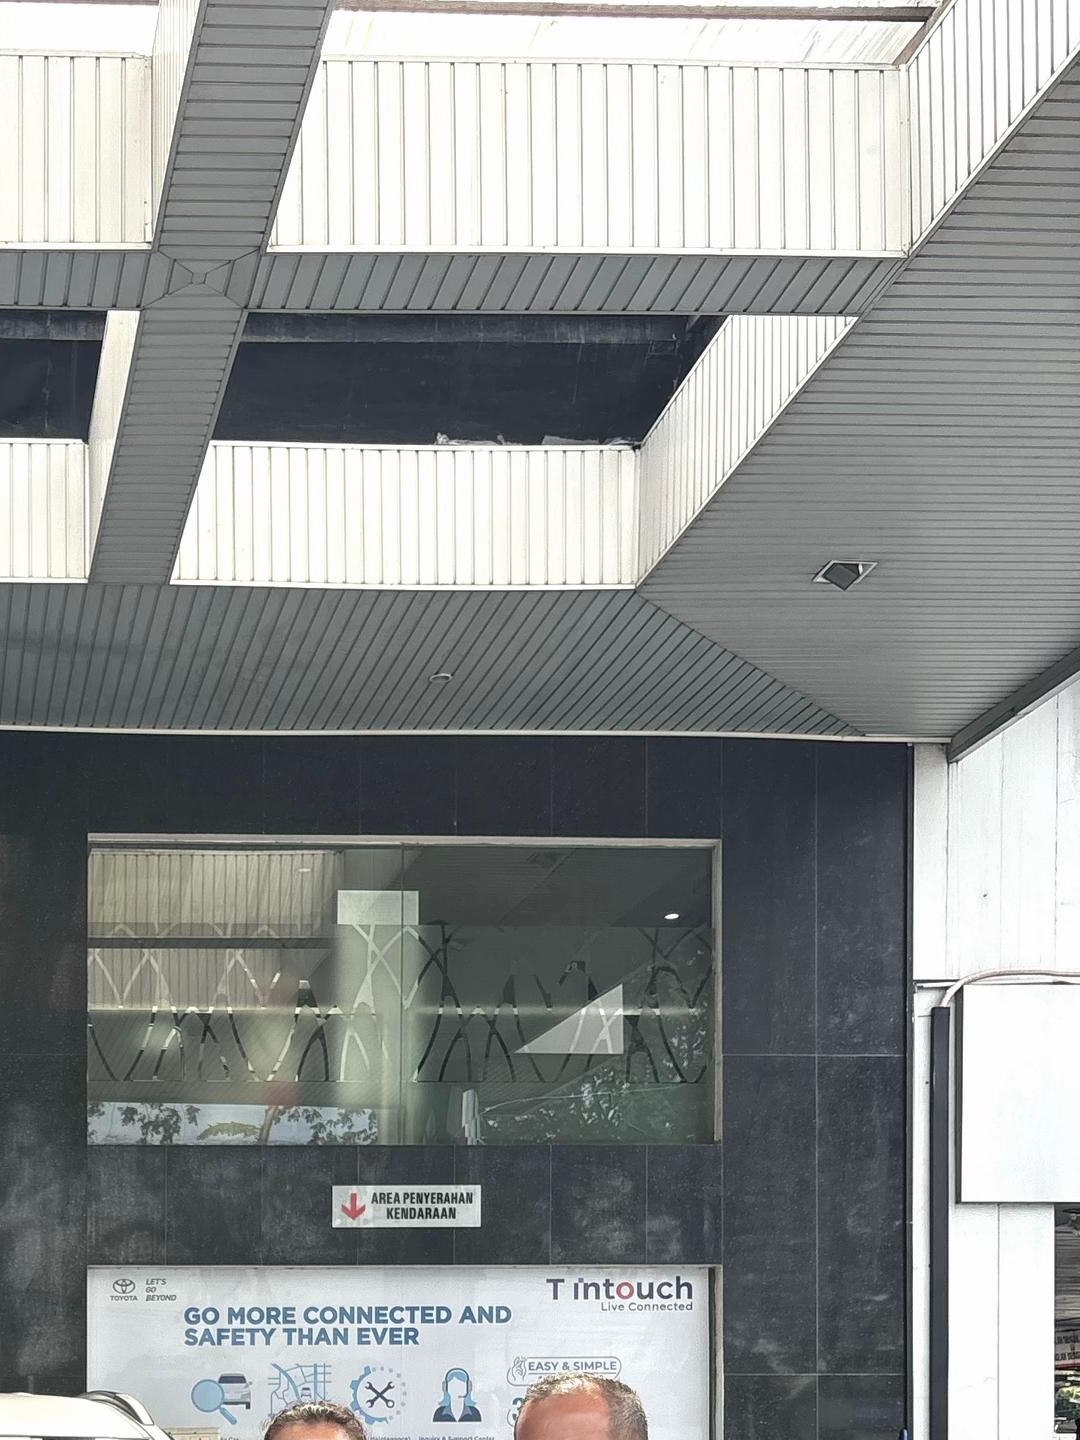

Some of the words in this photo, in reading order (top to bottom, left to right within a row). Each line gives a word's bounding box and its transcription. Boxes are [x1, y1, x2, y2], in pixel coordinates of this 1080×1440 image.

[371, 1192, 401, 1205] AREA
[403, 1192, 473, 1205] PENYERAHAN
[386, 1207, 457, 1220] KENDARAAN
[146, 1278, 167, 1286] LET'S
[573, 1276, 693, 1301] intouch
[146, 1294, 177, 1302] BEYOND
[601, 1302, 626, 1312] Live
[628, 1302, 693, 1312] Connected
[184, 1306, 220, 1325] GO
[227, 1306, 296, 1325] MORE
[303, 1305, 452, 1325] CONNECTED
[459, 1305, 512, 1324] AND
[184, 1328, 274, 1346] SAFETY
[286, 1328, 349, 1346] THAN
[357, 1327, 419, 1345] EVER
[528, 1361, 559, 1371] EASY
[573, 1361, 617, 1371] SIMPLE
